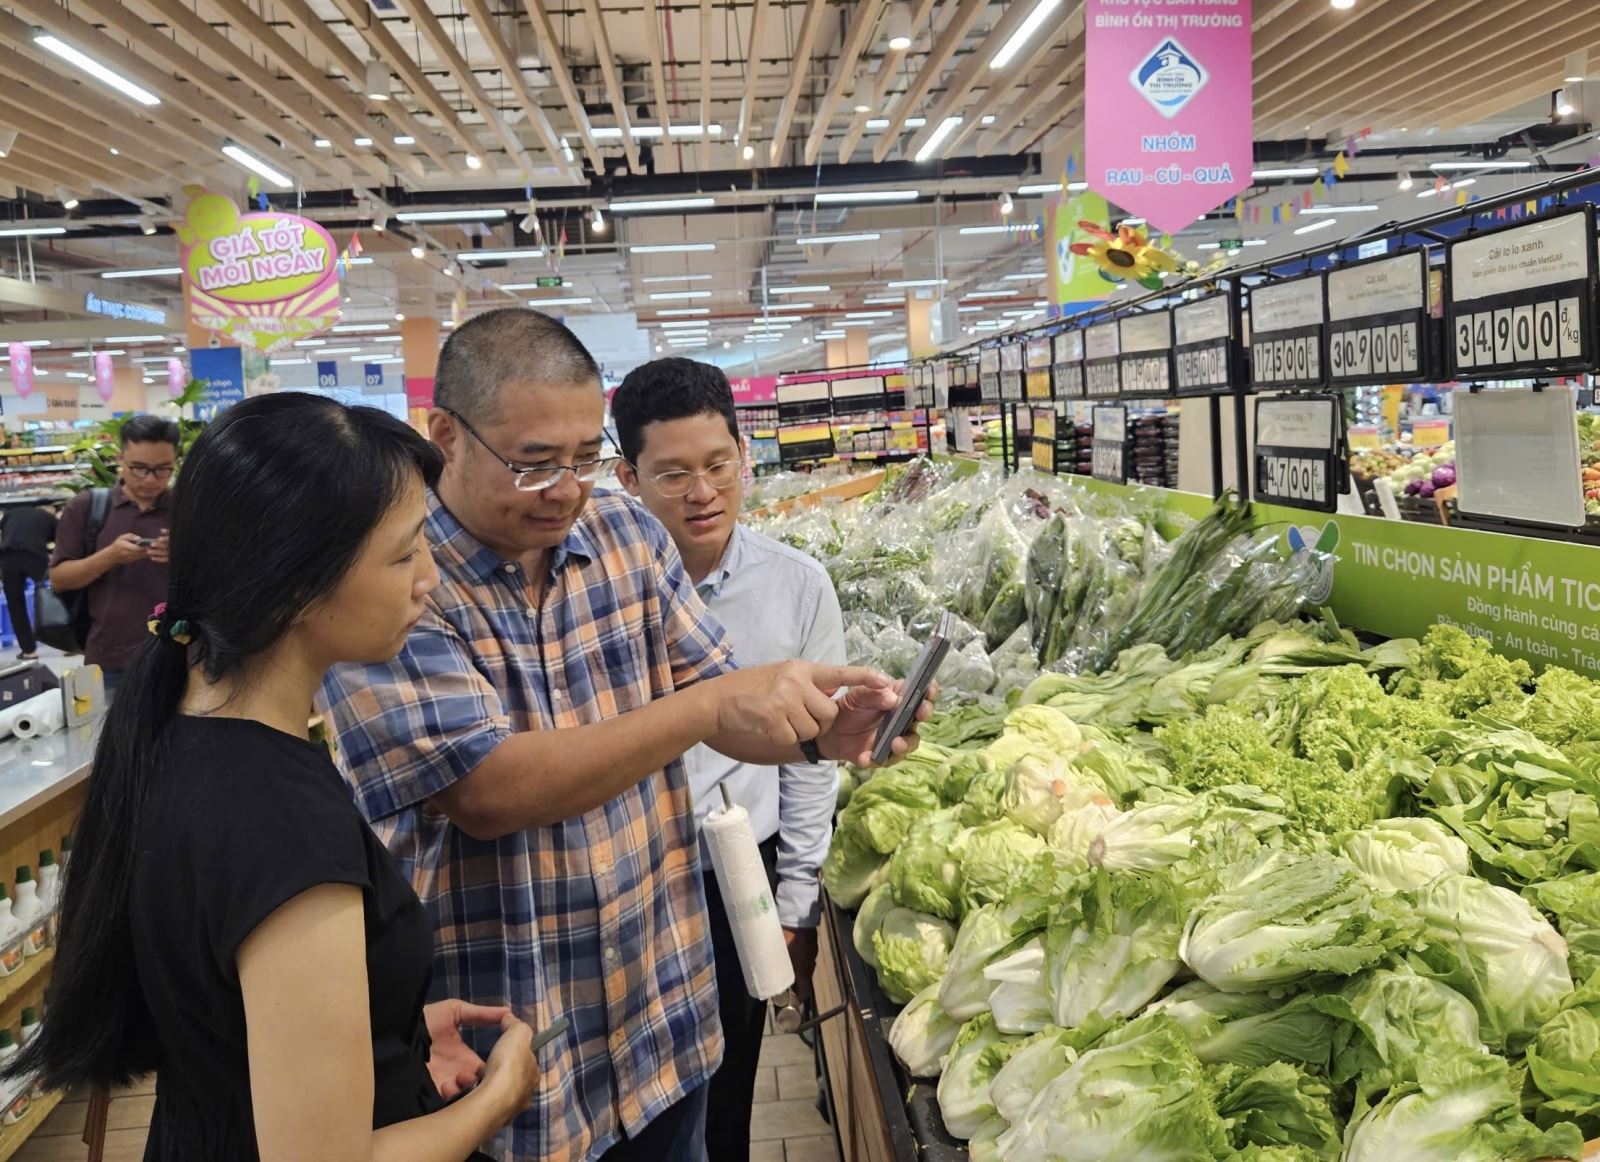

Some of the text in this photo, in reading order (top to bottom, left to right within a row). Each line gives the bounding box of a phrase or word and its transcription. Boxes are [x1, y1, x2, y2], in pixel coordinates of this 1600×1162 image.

[1095, 13, 1129, 28] BÌNH
[1155, 14, 1178, 30] THỊ
[1181, 12, 1244, 27] TRƯỜNG
[1143, 132, 1195, 151] NHÓM
[1107, 169, 1142, 184] RAU
[1155, 164, 1181, 184] CỦ
[1194, 163, 1233, 183] QUẢ
[211, 220, 304, 257] GIÁ TỐT
[1521, 240, 1544, 252] xanh
[254, 248, 324, 280] NGÀY
[1460, 311, 1553, 357] 34.900
[1256, 345, 1305, 372] 17.500
[1334, 333, 1399, 368] 30.900
[321, 374, 336, 386] 06
[367, 374, 380, 385] 07
[1268, 462, 1309, 492] 4.700
[1351, 541, 1379, 568] TIN
[1382, 547, 1435, 581] CHỌN
[1440, 551, 1480, 588] SẢN
[1487, 561, 1554, 602] PHẨM
[1467, 596, 1500, 622] Đồng
[1503, 604, 1538, 626] hành
[1541, 614, 1577, 640] cùng
[1505, 632, 1522, 650] An
[1526, 637, 1558, 660] toàn
